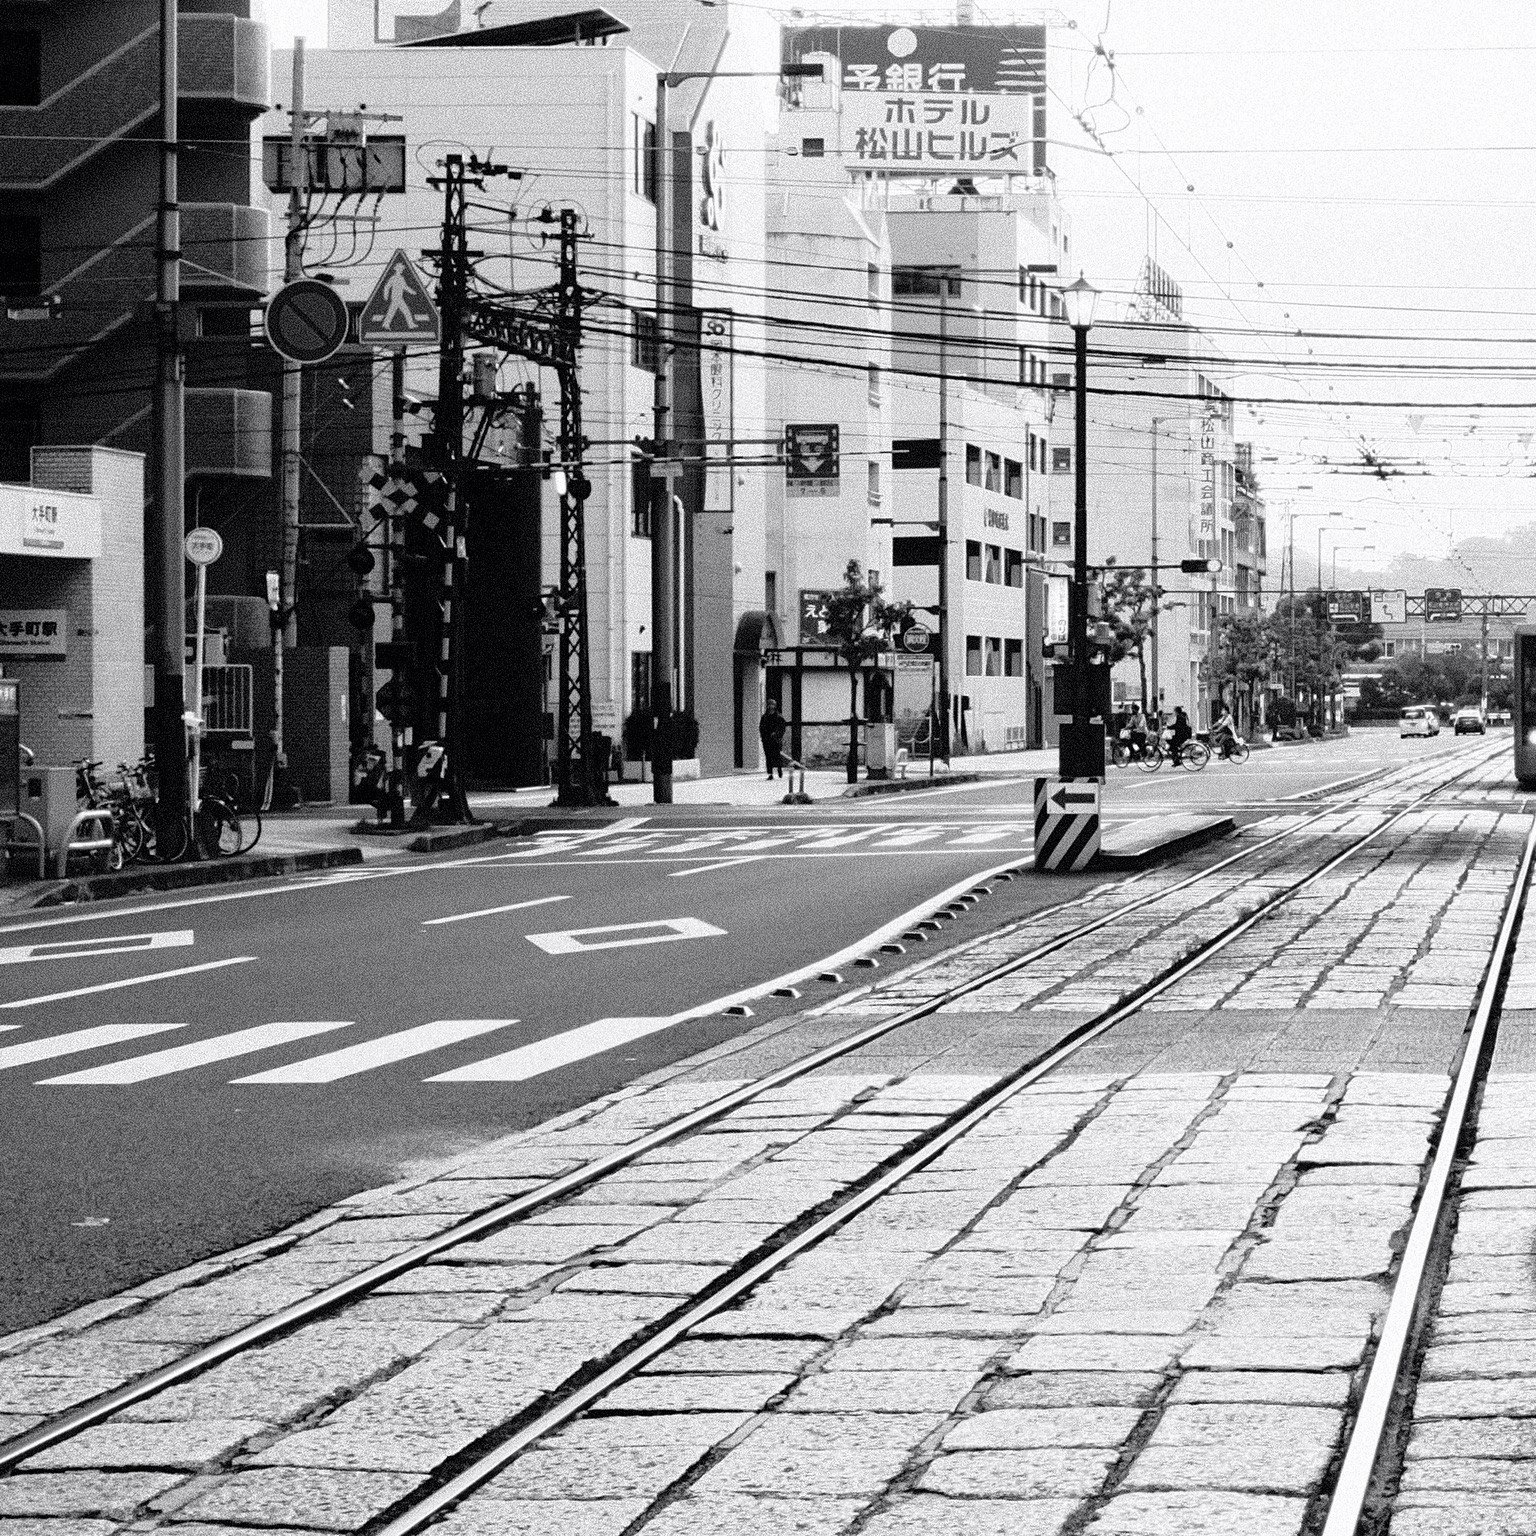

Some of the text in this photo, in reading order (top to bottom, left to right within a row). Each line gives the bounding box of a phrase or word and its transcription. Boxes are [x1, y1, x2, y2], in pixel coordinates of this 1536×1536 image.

[885, 97, 990, 125] ホテル
[856, 127, 1019, 161] 松山ヒルズ
